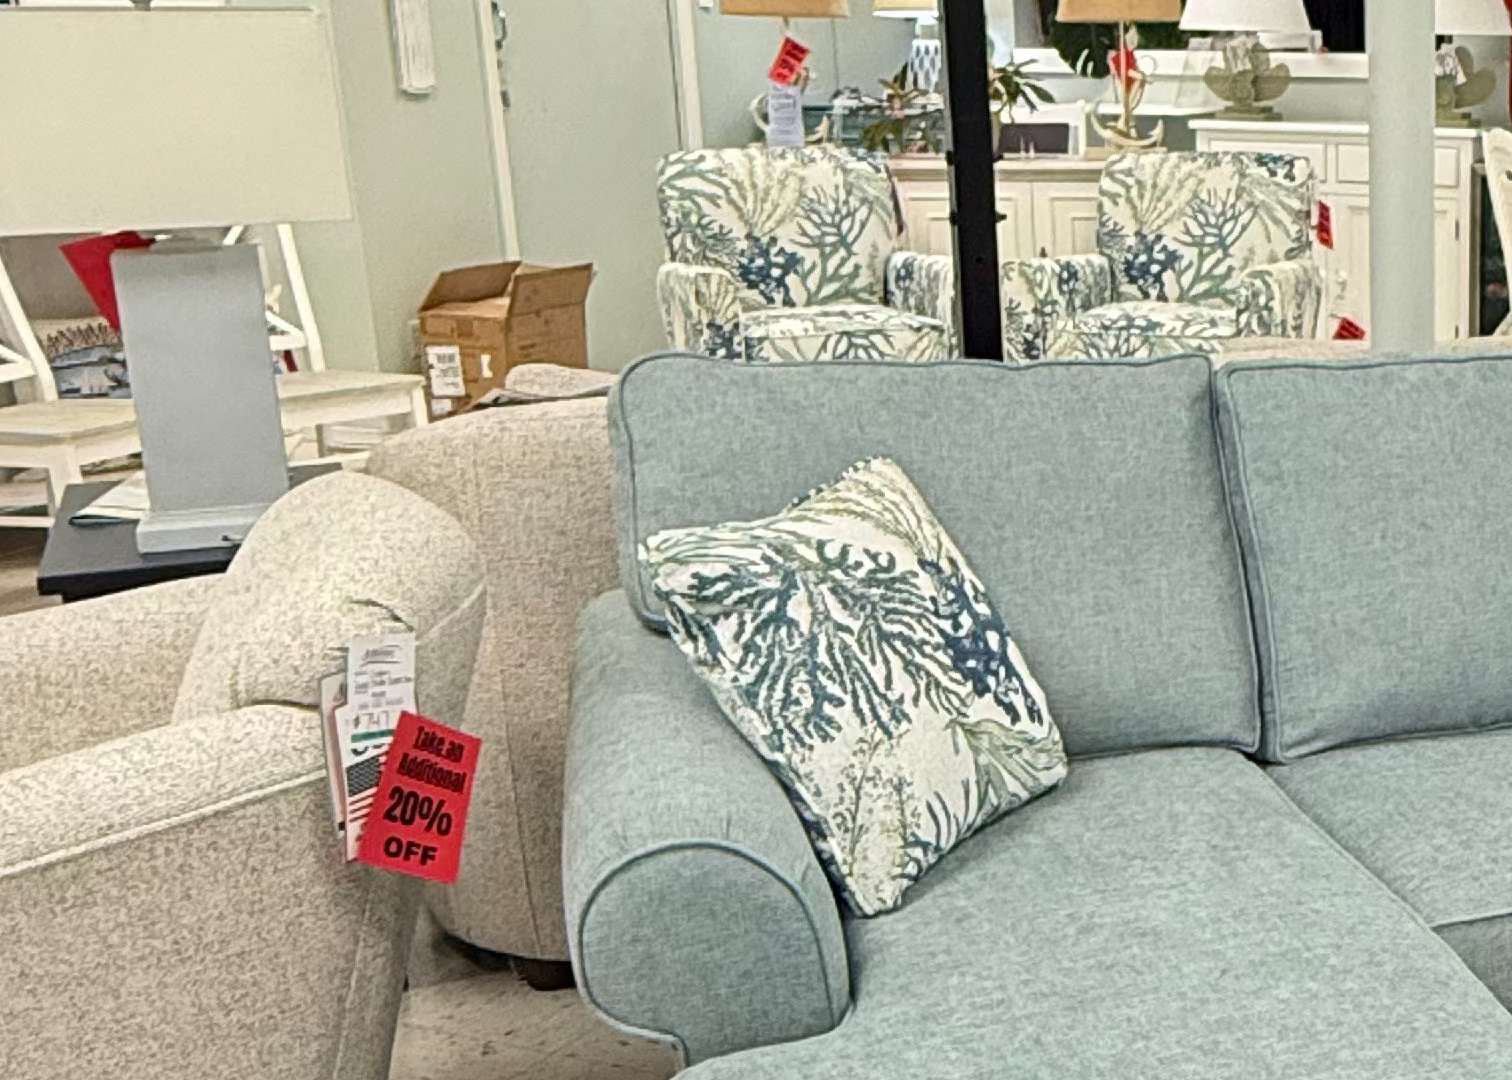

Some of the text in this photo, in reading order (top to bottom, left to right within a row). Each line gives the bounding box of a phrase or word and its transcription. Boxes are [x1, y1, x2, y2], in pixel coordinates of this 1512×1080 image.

[414, 725, 446, 758] Take
[445, 740, 465, 763] an
[396, 752, 467, 795] Additional
[383, 785, 453, 836] 20%
[383, 836, 439, 866] OFF
